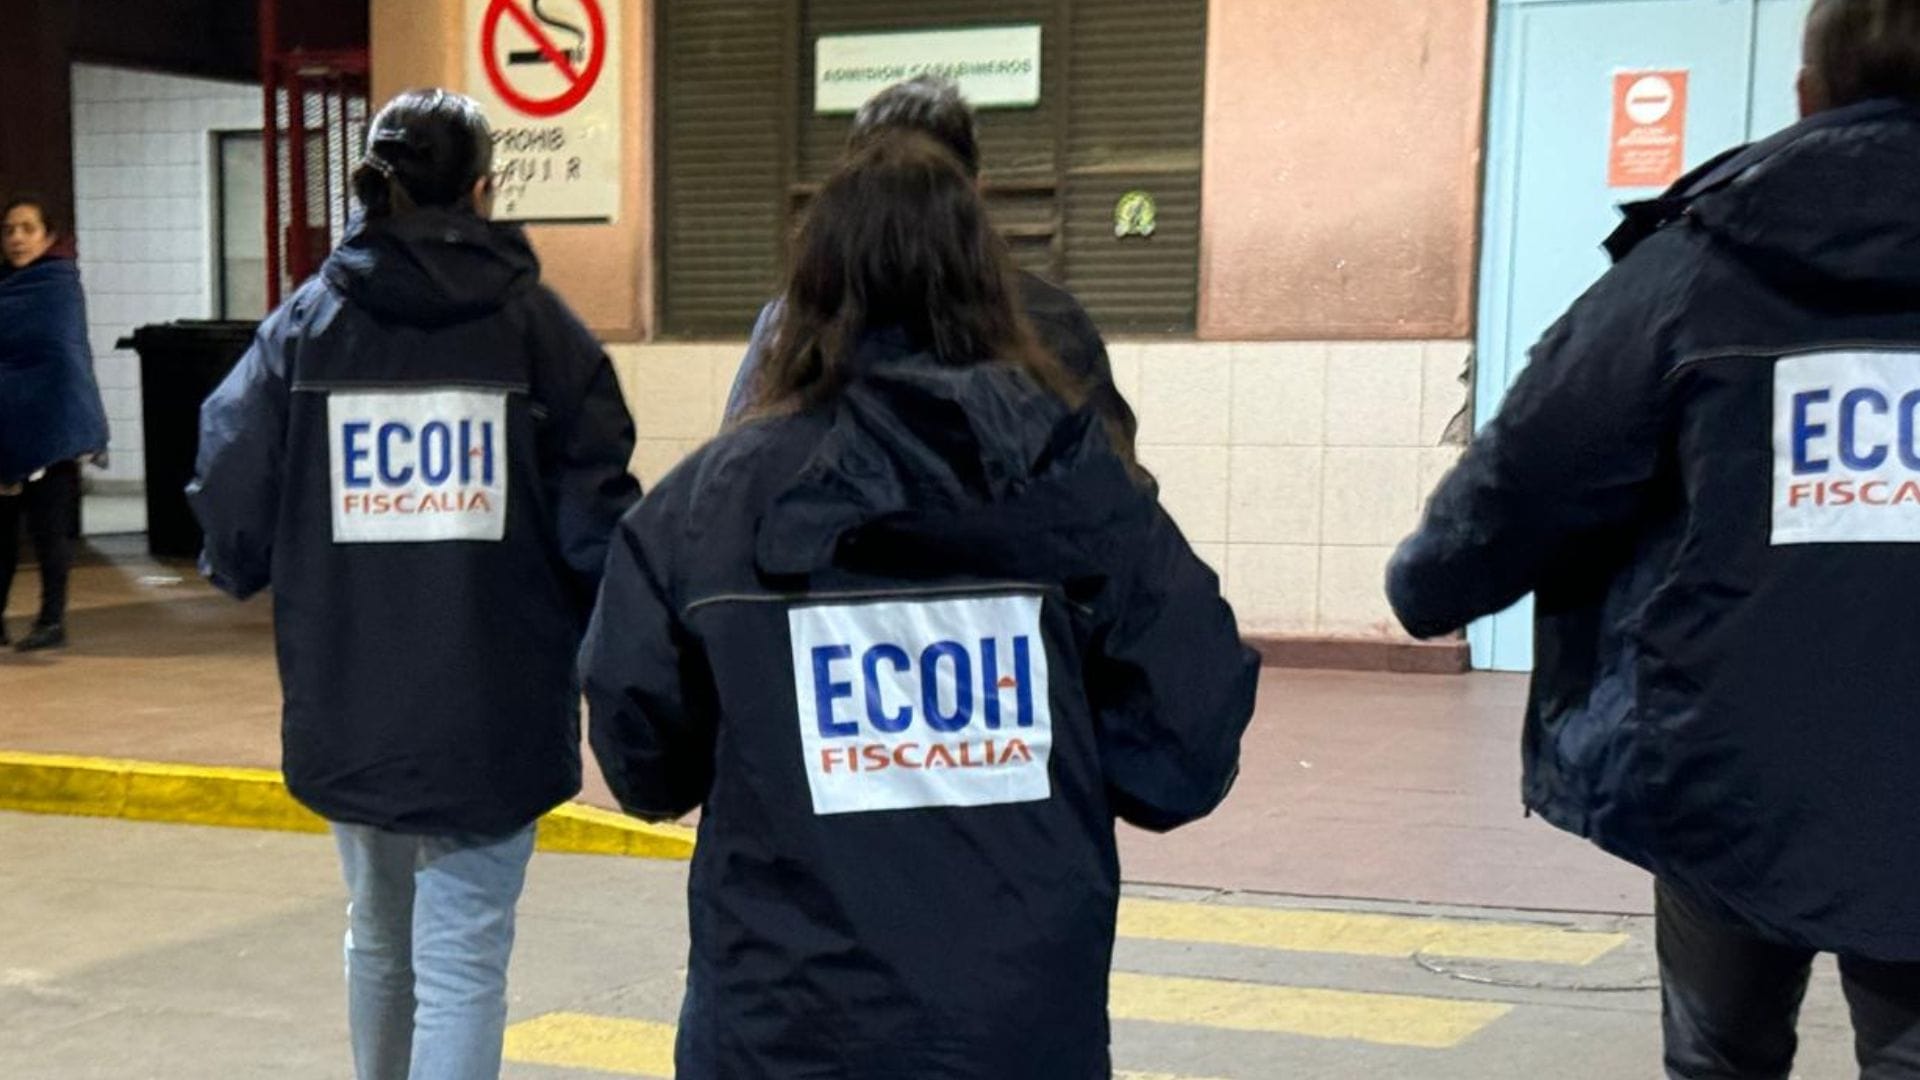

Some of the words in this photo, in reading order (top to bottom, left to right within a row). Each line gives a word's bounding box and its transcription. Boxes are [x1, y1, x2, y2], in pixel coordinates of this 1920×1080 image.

[344, 420, 493, 486] ECOH
[344, 491, 493, 514] FISCALIA
[811, 635, 1033, 738] ECOH
[821, 738, 1033, 773] FISCALIA
